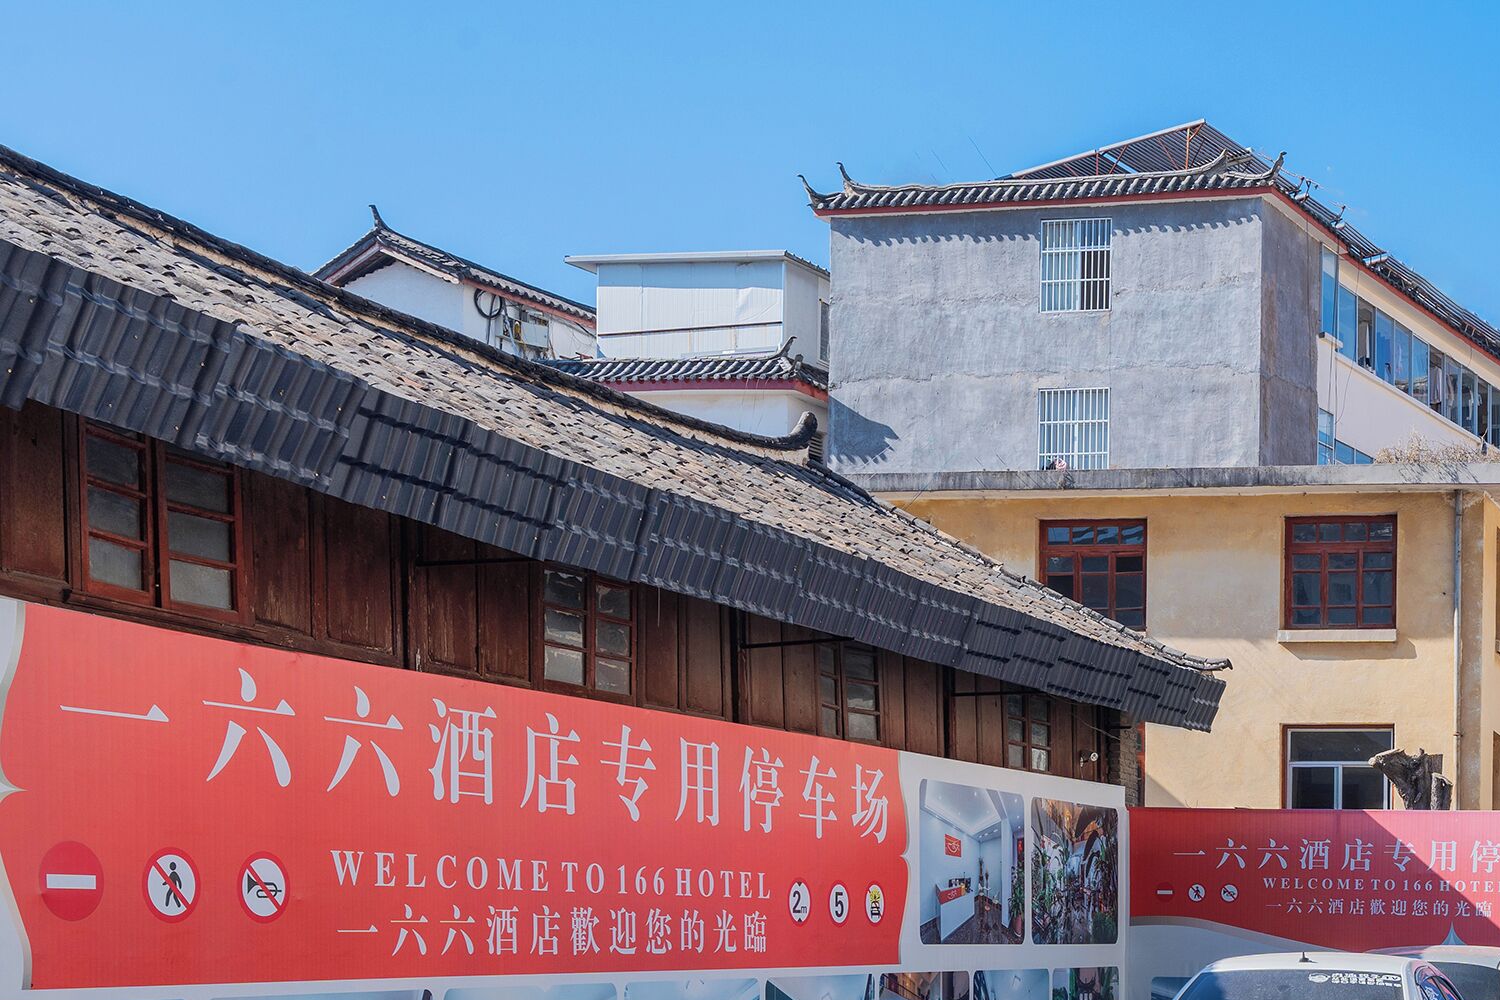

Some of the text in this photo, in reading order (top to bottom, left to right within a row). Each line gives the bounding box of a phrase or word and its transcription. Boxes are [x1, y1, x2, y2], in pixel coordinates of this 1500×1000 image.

[60, 667, 889, 845] 一六六酒店专用停车场
[330, 849, 771, 899] WELCOME TO 166 HOTEL
[1263, 876, 1364, 892] WELCOME
[1371, 878, 1396, 892] TO
[1403, 878, 1433, 893] 166
[834, 891, 845, 918] 5
[1265, 898, 1492, 918] 一六六酒店歡迎您的光臨
[337, 904, 767, 956] 一六六酒店歡迎您的光臨
